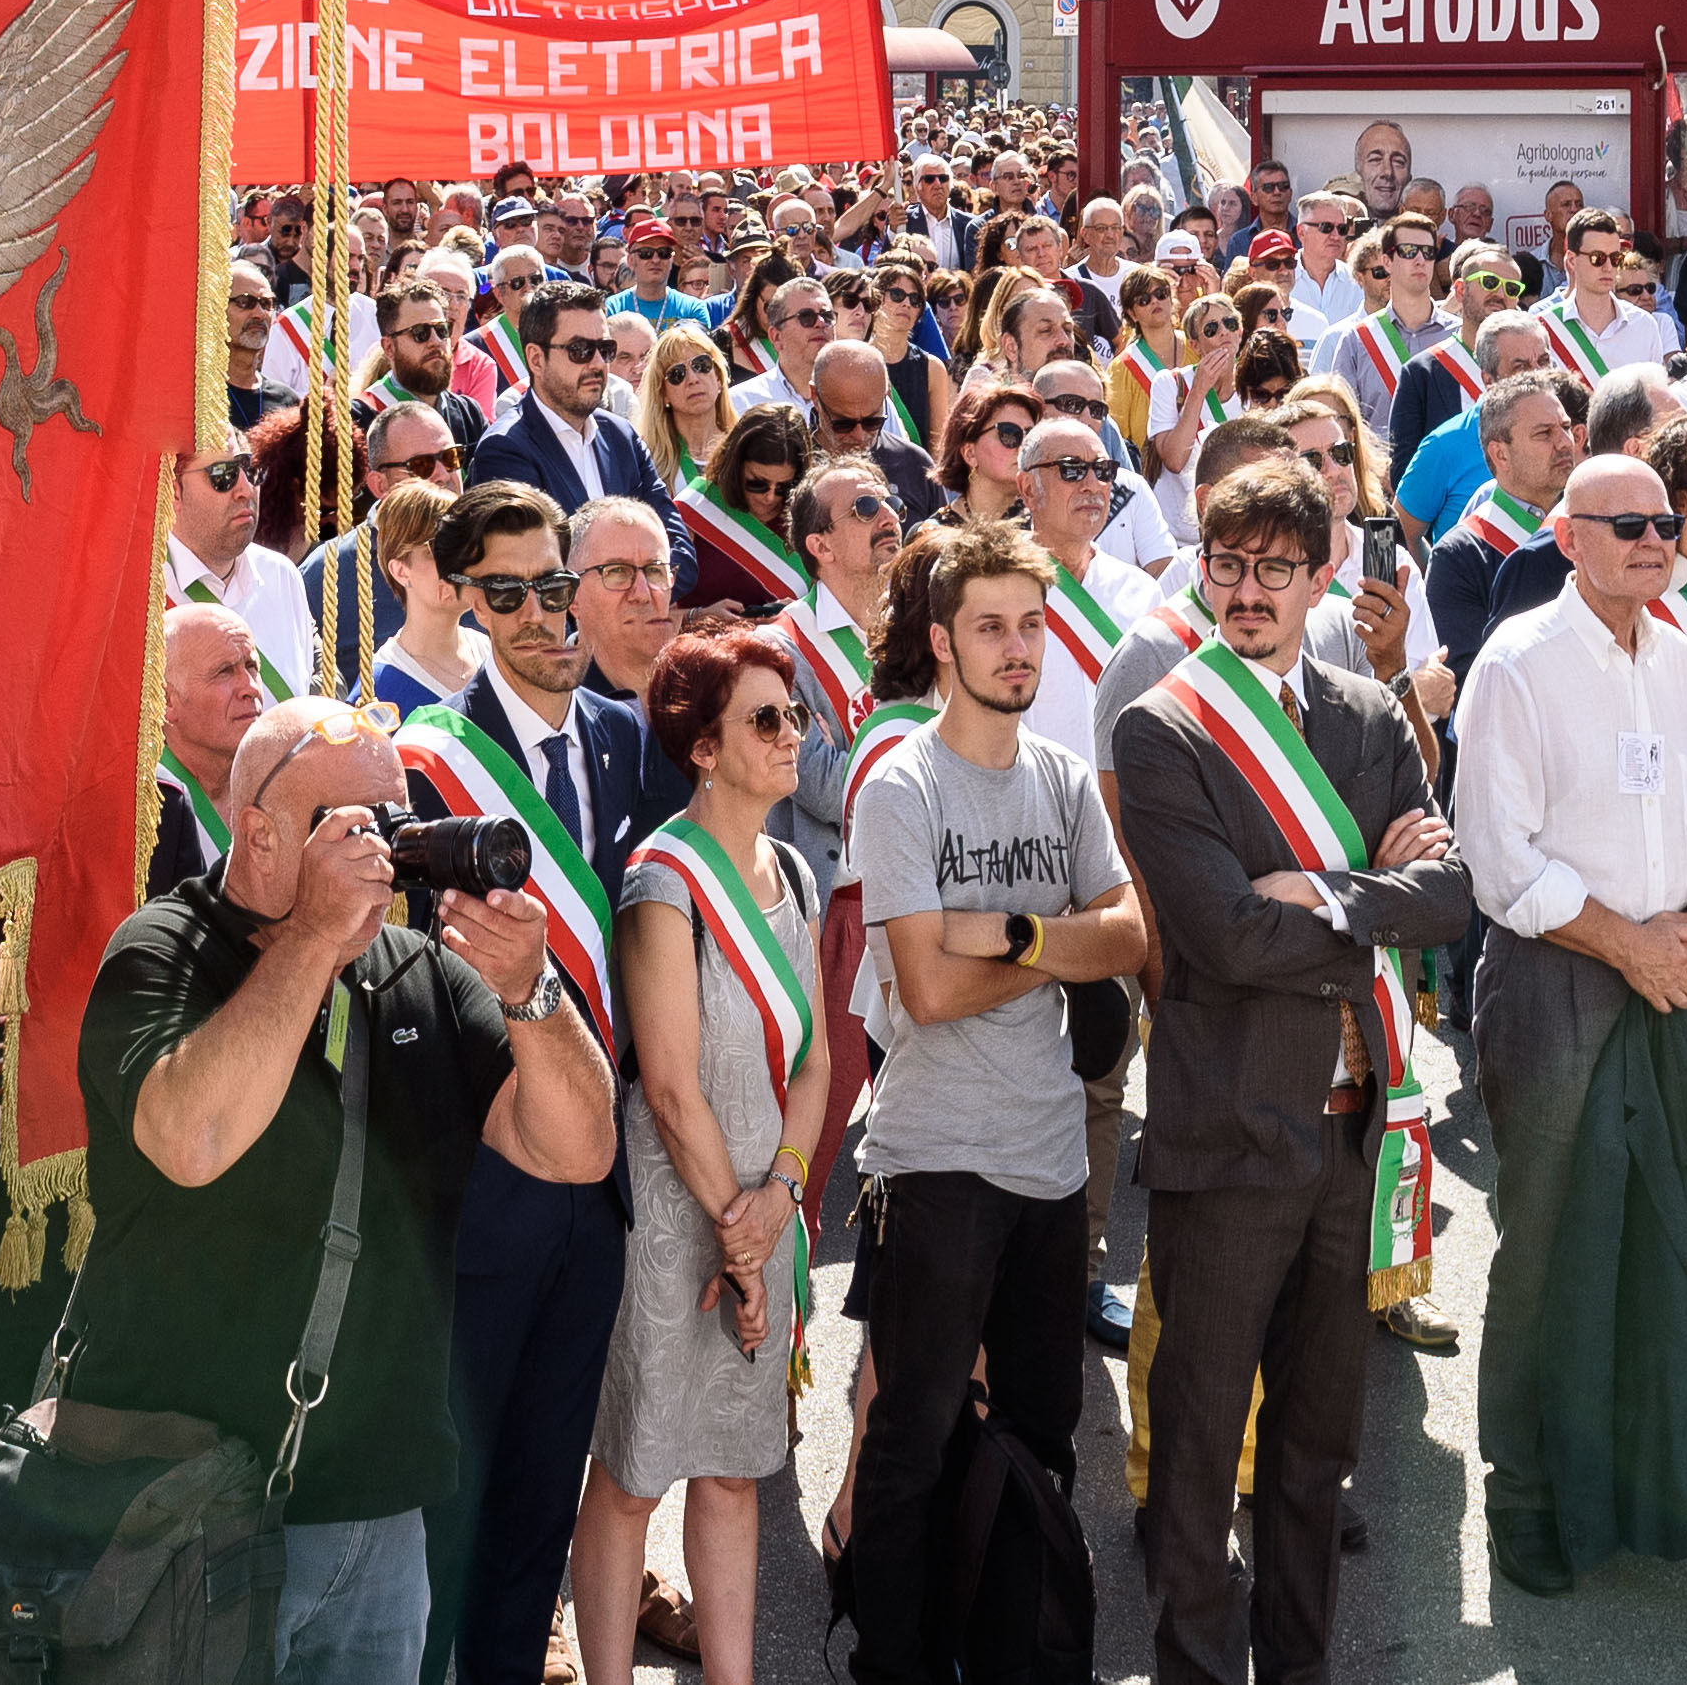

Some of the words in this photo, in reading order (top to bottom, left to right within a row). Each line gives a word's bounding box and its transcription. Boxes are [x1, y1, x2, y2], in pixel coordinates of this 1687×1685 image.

[239, 22, 424, 91] ZIONE
[459, 13, 823, 97] ELETTRICA
[1596, 100, 1615, 110] 261
[468, 103, 774, 174] BOLOGNA
[1516, 143, 1594, 164] Agribologna
[1517, 165, 1528, 178] la
[1529, 165, 1557, 183] qualità
[1570, 168, 1608, 182] persona
[1515, 223, 1552, 248] QUES
[937, 827, 1069, 892] ALTAMONT
